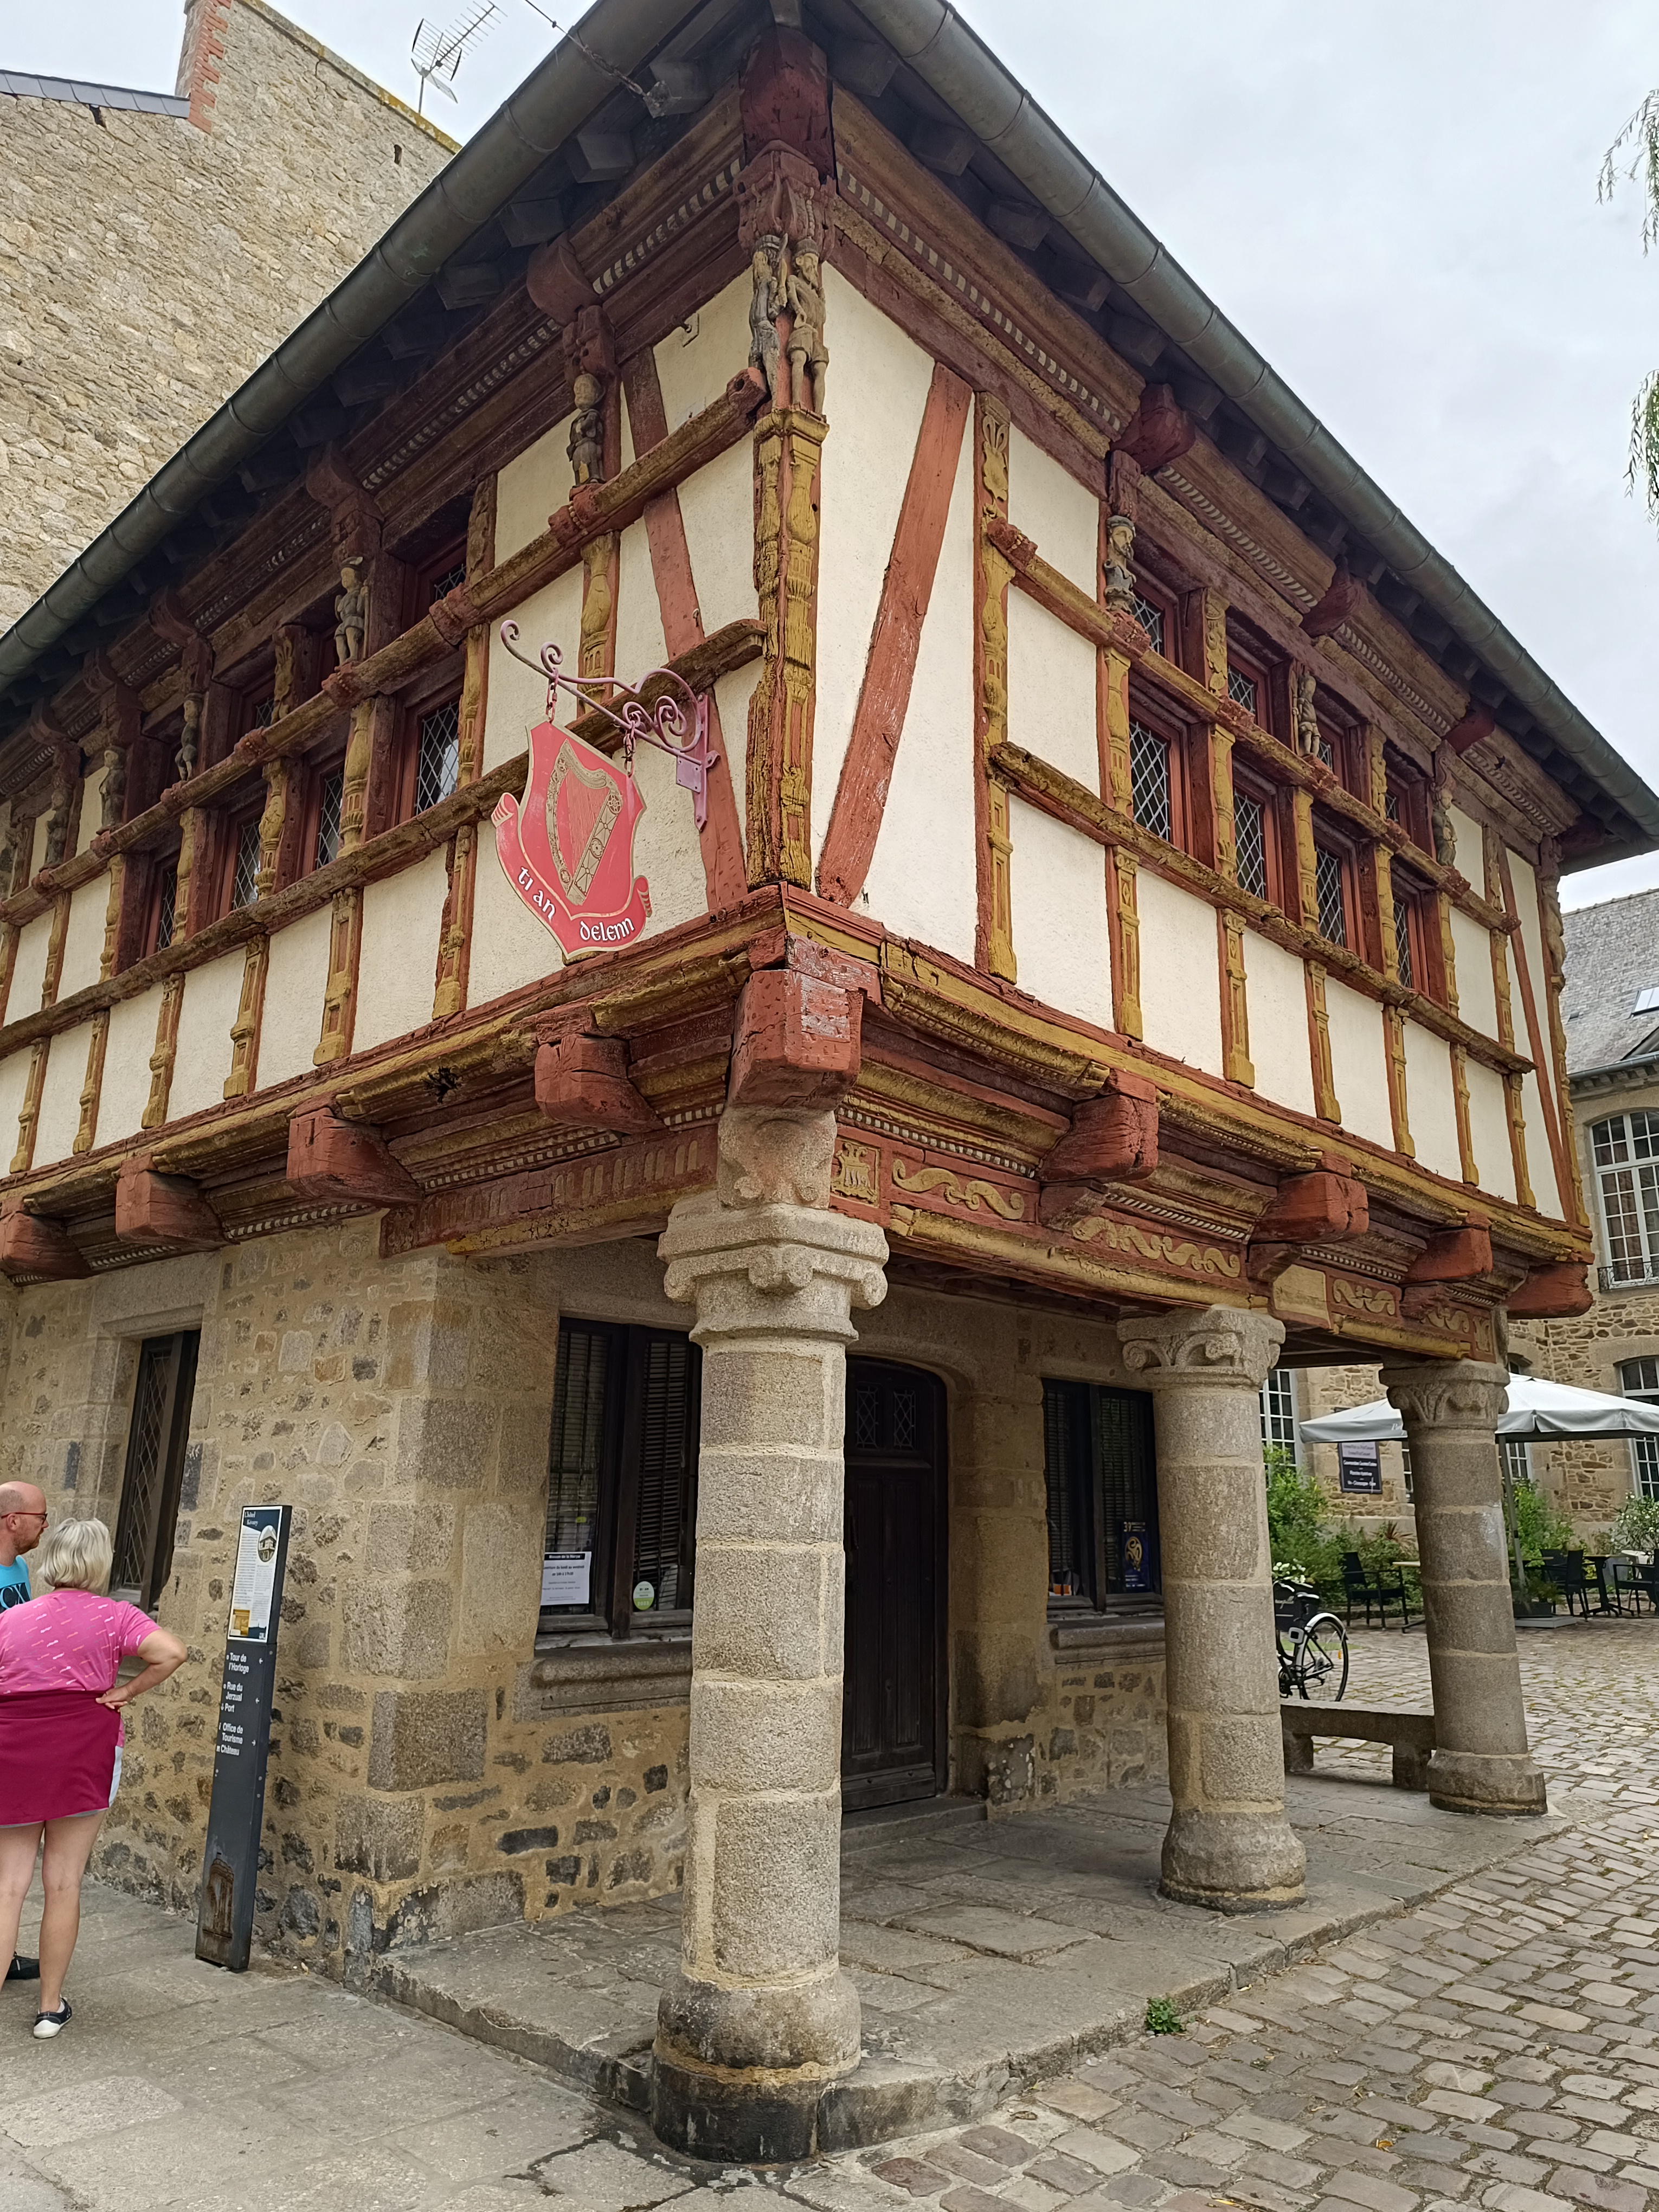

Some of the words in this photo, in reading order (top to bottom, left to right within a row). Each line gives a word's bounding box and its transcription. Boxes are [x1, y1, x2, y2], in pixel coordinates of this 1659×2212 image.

[532, 890, 556, 921] an
[580, 917, 635, 941] delenn
[230, 1652, 240, 1662] Tour
[240, 1654, 247, 1663] de
[227, 1681, 236, 1691] Rue
[236, 1683, 243, 1692] du
[224, 1703, 235, 1713] Port
[222, 1722, 236, 1733] Office
[236, 1725, 243, 1734] de
[222, 1732, 243, 1745] Tourisme
[221, 1744, 240, 1756] Château
